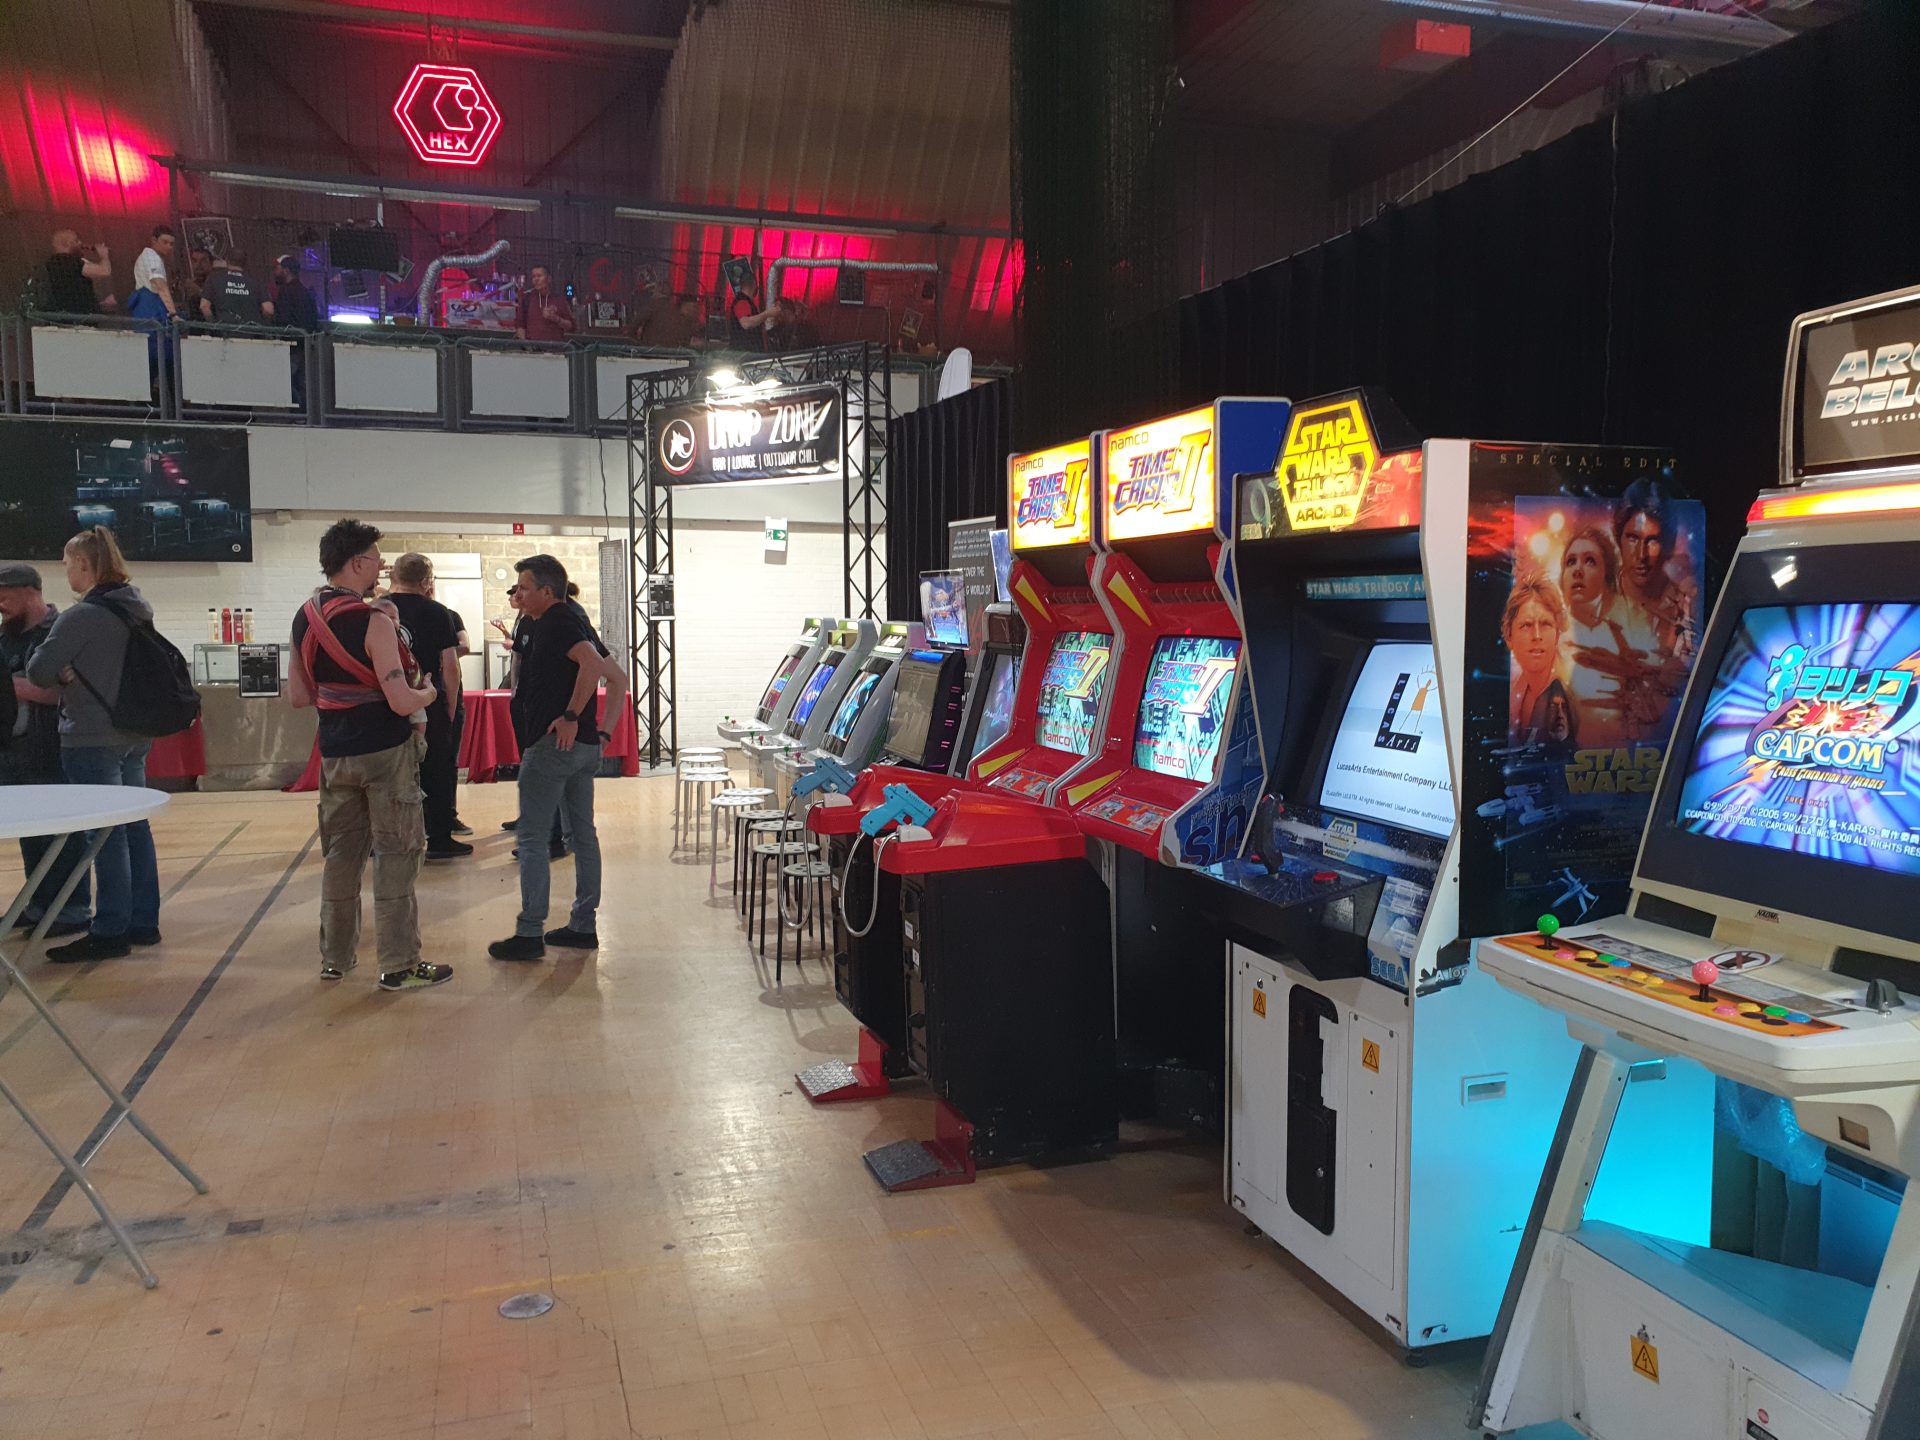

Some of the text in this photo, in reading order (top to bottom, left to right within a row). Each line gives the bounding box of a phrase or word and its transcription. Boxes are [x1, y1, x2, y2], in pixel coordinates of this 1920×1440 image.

[429, 131, 468, 151] HEX
[1828, 342, 1920, 386] AR
[1820, 377, 1920, 419] BEL
[707, 401, 824, 451] DROP ZONE
[1297, 417, 1356, 452] STAR
[1110, 431, 1149, 452] namco
[713, 448, 819, 472] BAR LOUNGE OUTDOOR CHILL
[1015, 457, 1044, 473] namco
[1128, 446, 1177, 480] TIME
[1295, 446, 1352, 481] WARS
[1500, 453, 1603, 467] SPECIAL
[1028, 471, 1065, 498] TIME
[1294, 473, 1356, 501] TRILOGY
[1017, 491, 1067, 529] CRISIS
[1295, 505, 1352, 523] ARCADE
[1306, 581, 1425, 594] STAR WARS TRILOGY A
[1793, 666, 1914, 707] タツノコ
[1377, 679, 1406, 743] LUCAS
[1044, 732, 1073, 747] namco
[1386, 735, 1418, 752] Arts
[1755, 730, 1886, 772] CAPCOM
[1153, 752, 1185, 769] namco
[1565, 747, 1664, 772] STAR
[1336, 761, 1362, 773] LucasArts
[1362, 765, 1403, 781] Entertainment
[1403, 772, 1437, 790] Company
[1772, 765, 1799, 780] CROSS
[1795, 767, 1840, 783] GENERATION
[1850, 775, 1886, 790] HEROES
[1853, 834, 1868, 847] ALL
[1871, 838, 1903, 853] RIGHTS
[1371, 955, 1409, 988] SEGA
